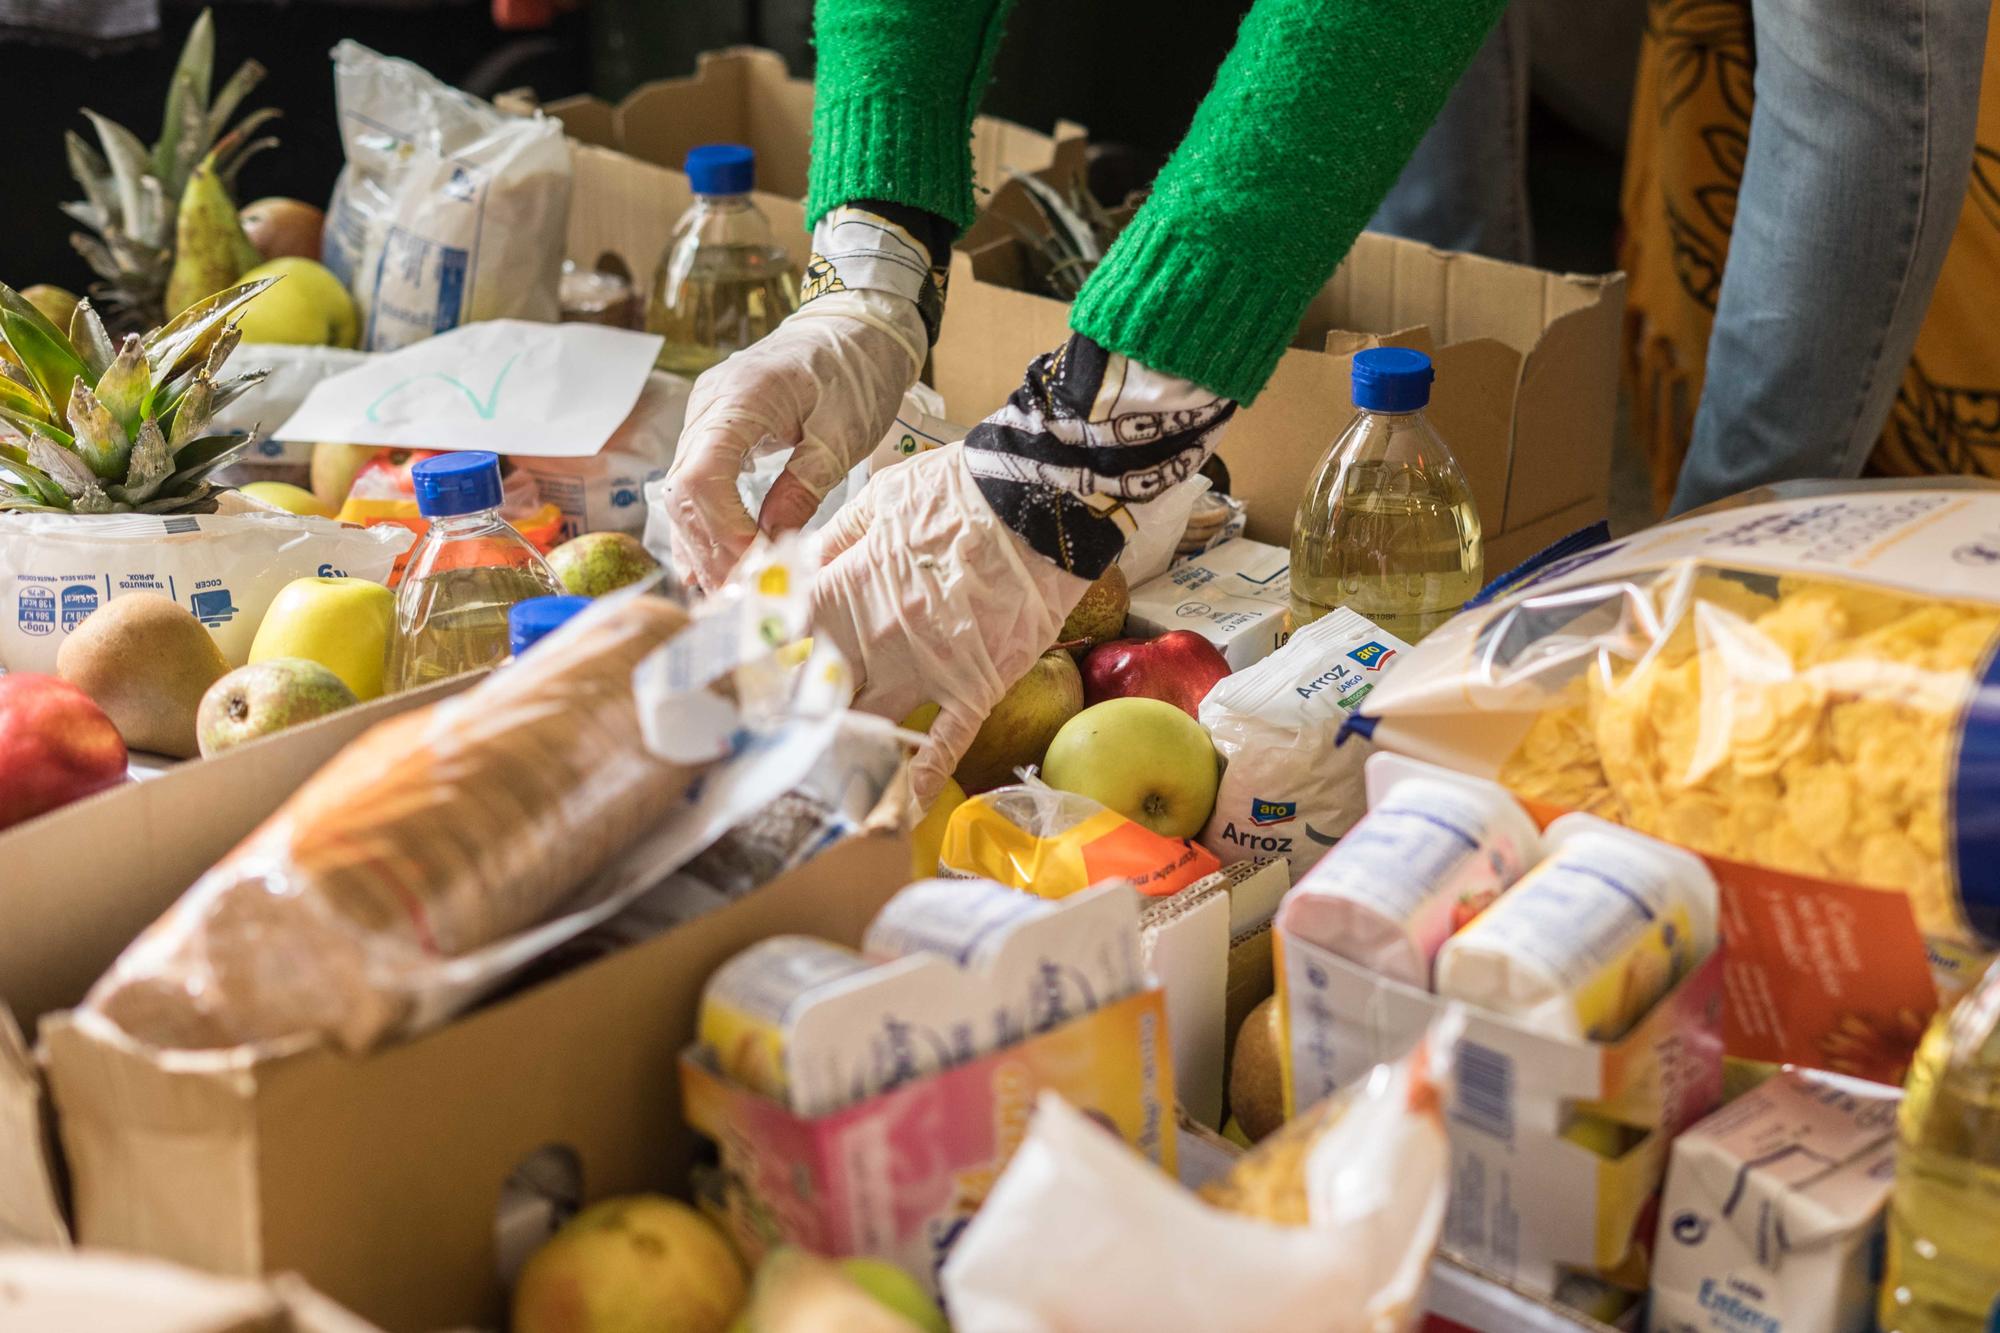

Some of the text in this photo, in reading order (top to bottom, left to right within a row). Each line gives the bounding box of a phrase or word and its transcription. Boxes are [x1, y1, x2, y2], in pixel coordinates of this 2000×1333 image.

[119, 581, 154, 589] MINUTOS
[194, 578, 222, 589] COCER
[38, 599, 53, 608] 138
[1356, 644, 1381, 661] aro
[1296, 663, 1351, 700] Arroz
[1336, 674, 1364, 694] LARGO
[1260, 803, 1288, 816] aro
[1221, 822, 1293, 853] Arroz
